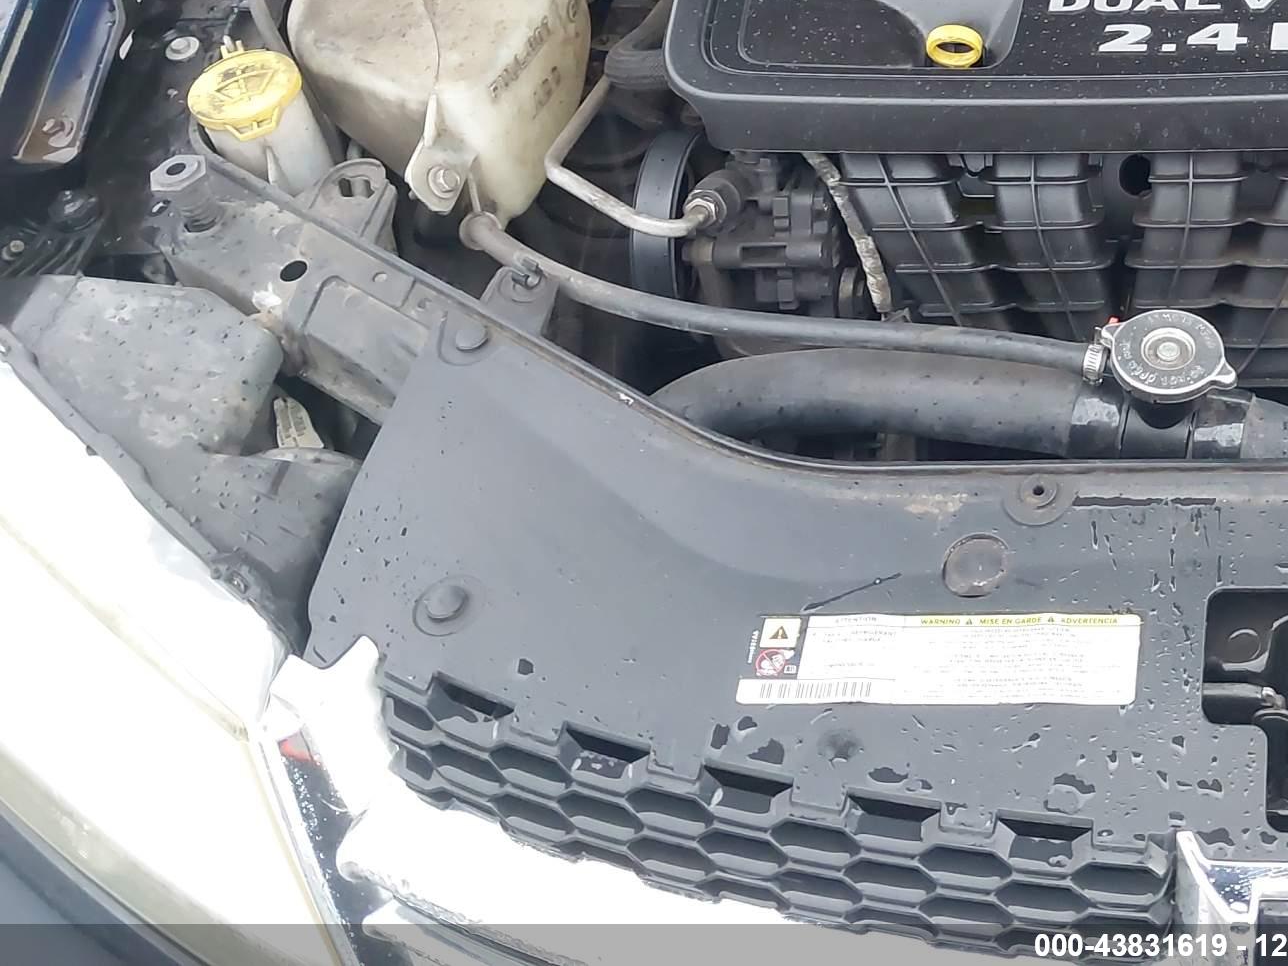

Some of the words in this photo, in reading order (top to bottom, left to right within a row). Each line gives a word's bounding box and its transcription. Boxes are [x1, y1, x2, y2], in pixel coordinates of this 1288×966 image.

[920, 618, 961, 626] WARNING
[979, 618, 1000, 626] MISE
[1001, 618, 1013, 626] EN
[1014, 616, 1042, 625] GARDE
[1060, 617, 1119, 625] ADVERTENCIA
